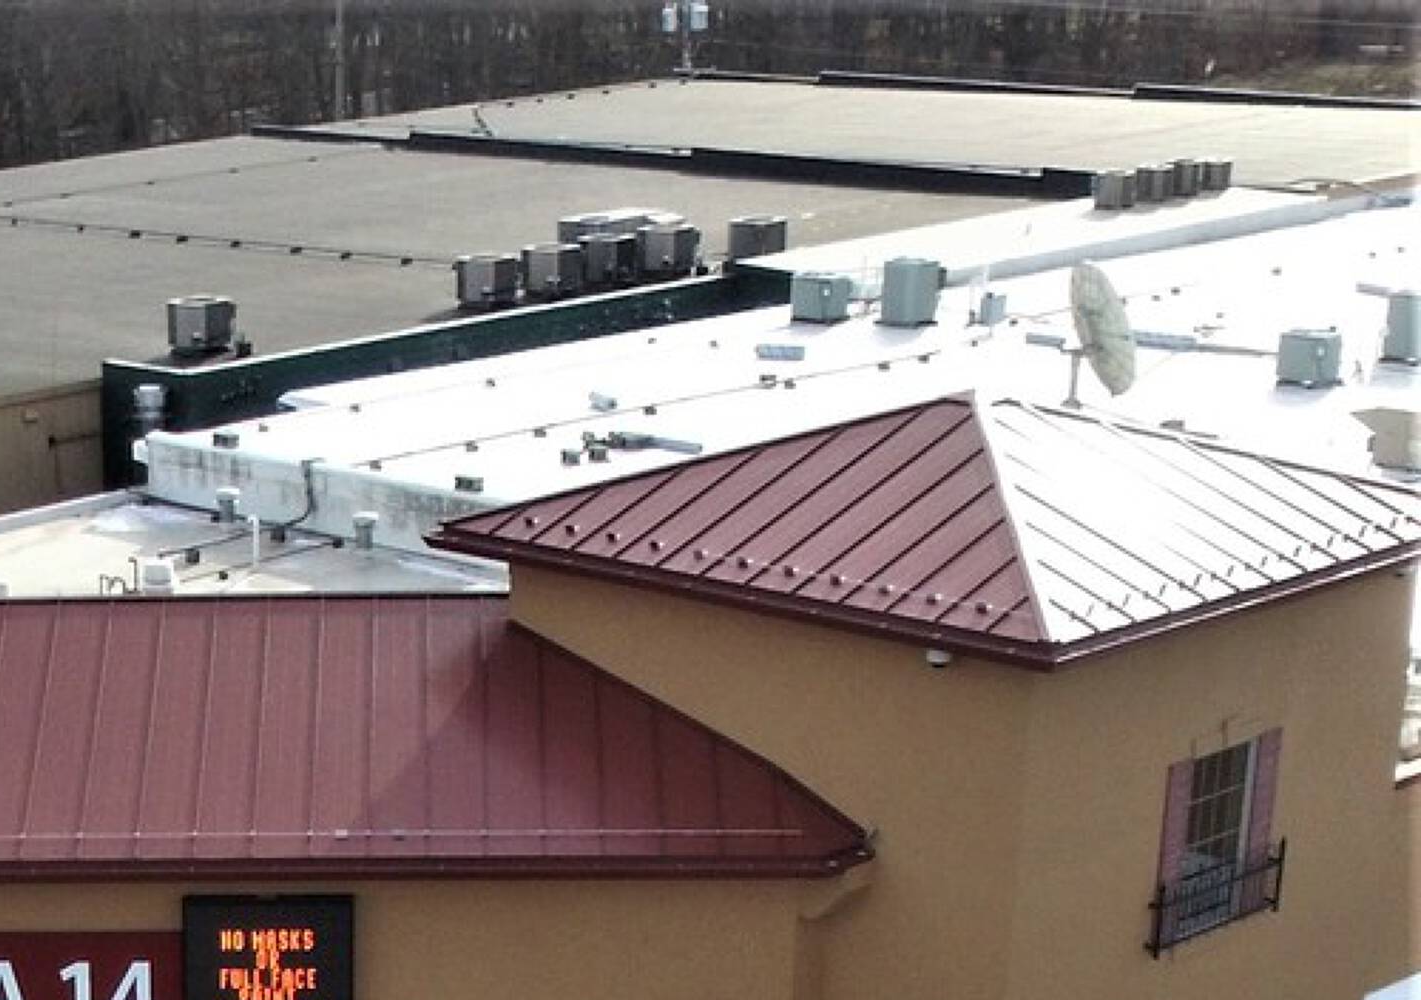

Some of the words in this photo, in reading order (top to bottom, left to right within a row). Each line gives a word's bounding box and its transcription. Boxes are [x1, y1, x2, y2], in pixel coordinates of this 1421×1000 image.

[220, 929, 244, 951] NO
[253, 929, 314, 951] MASKS
[219, 968, 263, 989] FULL
[272, 968, 317, 989] FACE
